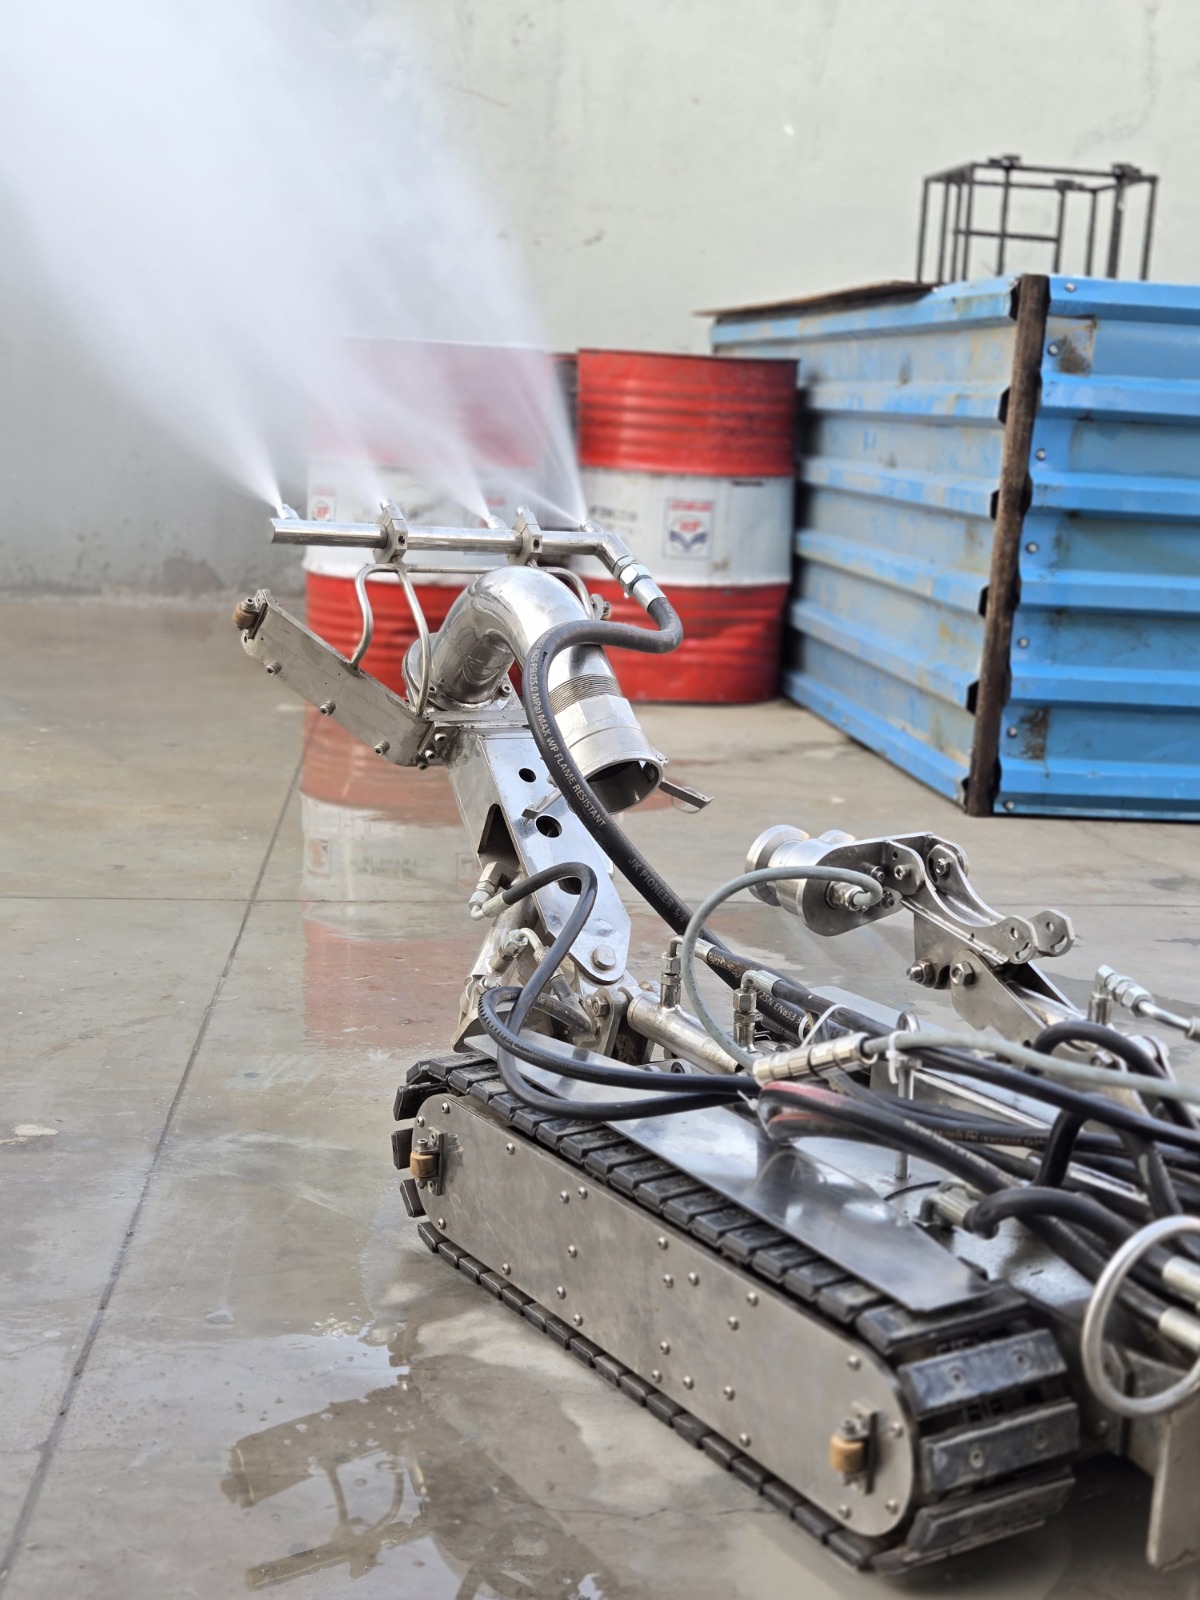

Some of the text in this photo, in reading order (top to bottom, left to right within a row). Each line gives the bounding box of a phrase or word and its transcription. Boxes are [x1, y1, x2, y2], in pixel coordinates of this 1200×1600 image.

[537, 714, 552, 736] MAX
[546, 736, 559, 752] WP
[554, 753, 576, 785] FLAME
[572, 783, 606, 826] RESISTANT
[628, 858, 642, 872] JK
[639, 869, 674, 908] PIONEER
[773, 1000, 796, 1021] EN853
